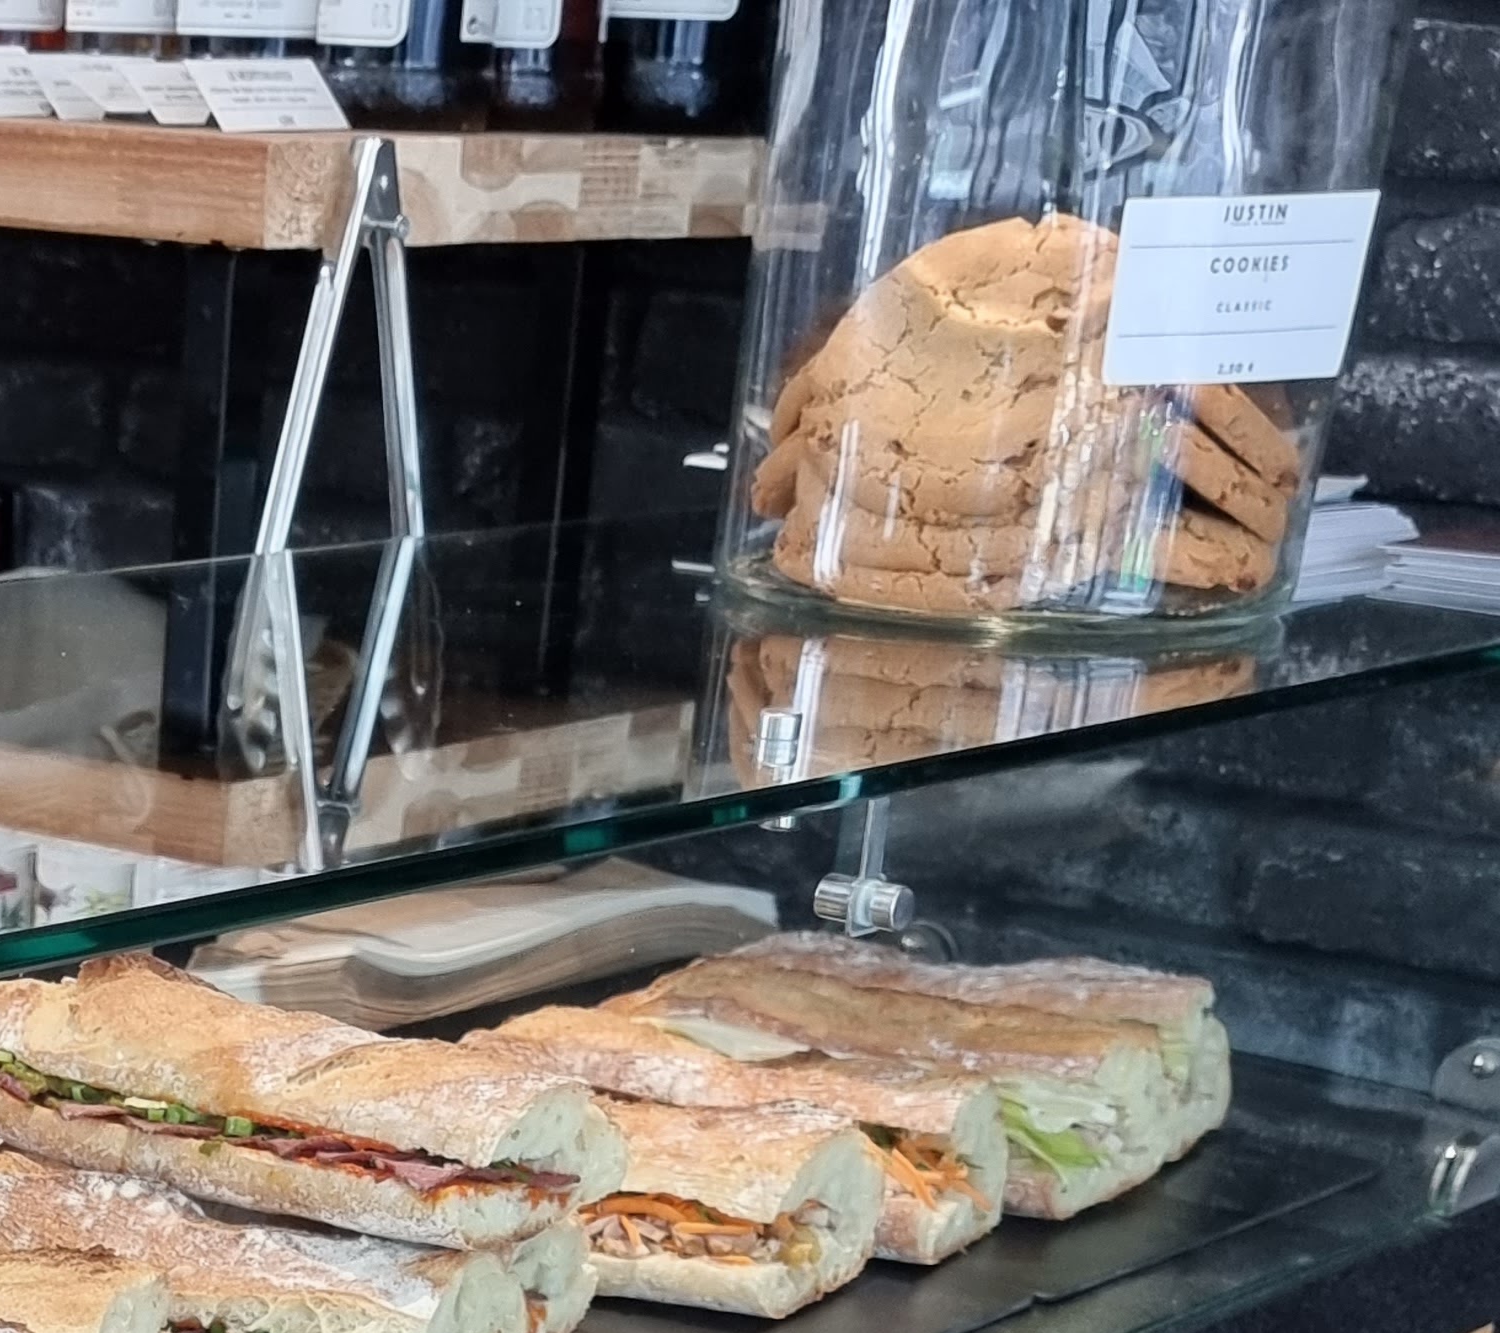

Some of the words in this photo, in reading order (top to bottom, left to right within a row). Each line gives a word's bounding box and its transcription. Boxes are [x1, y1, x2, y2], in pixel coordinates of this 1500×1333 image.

[1223, 204, 1289, 224] JUSTIN
[1209, 255, 1290, 274] COOKIES
[1215, 300, 1273, 314] CLASSIC
